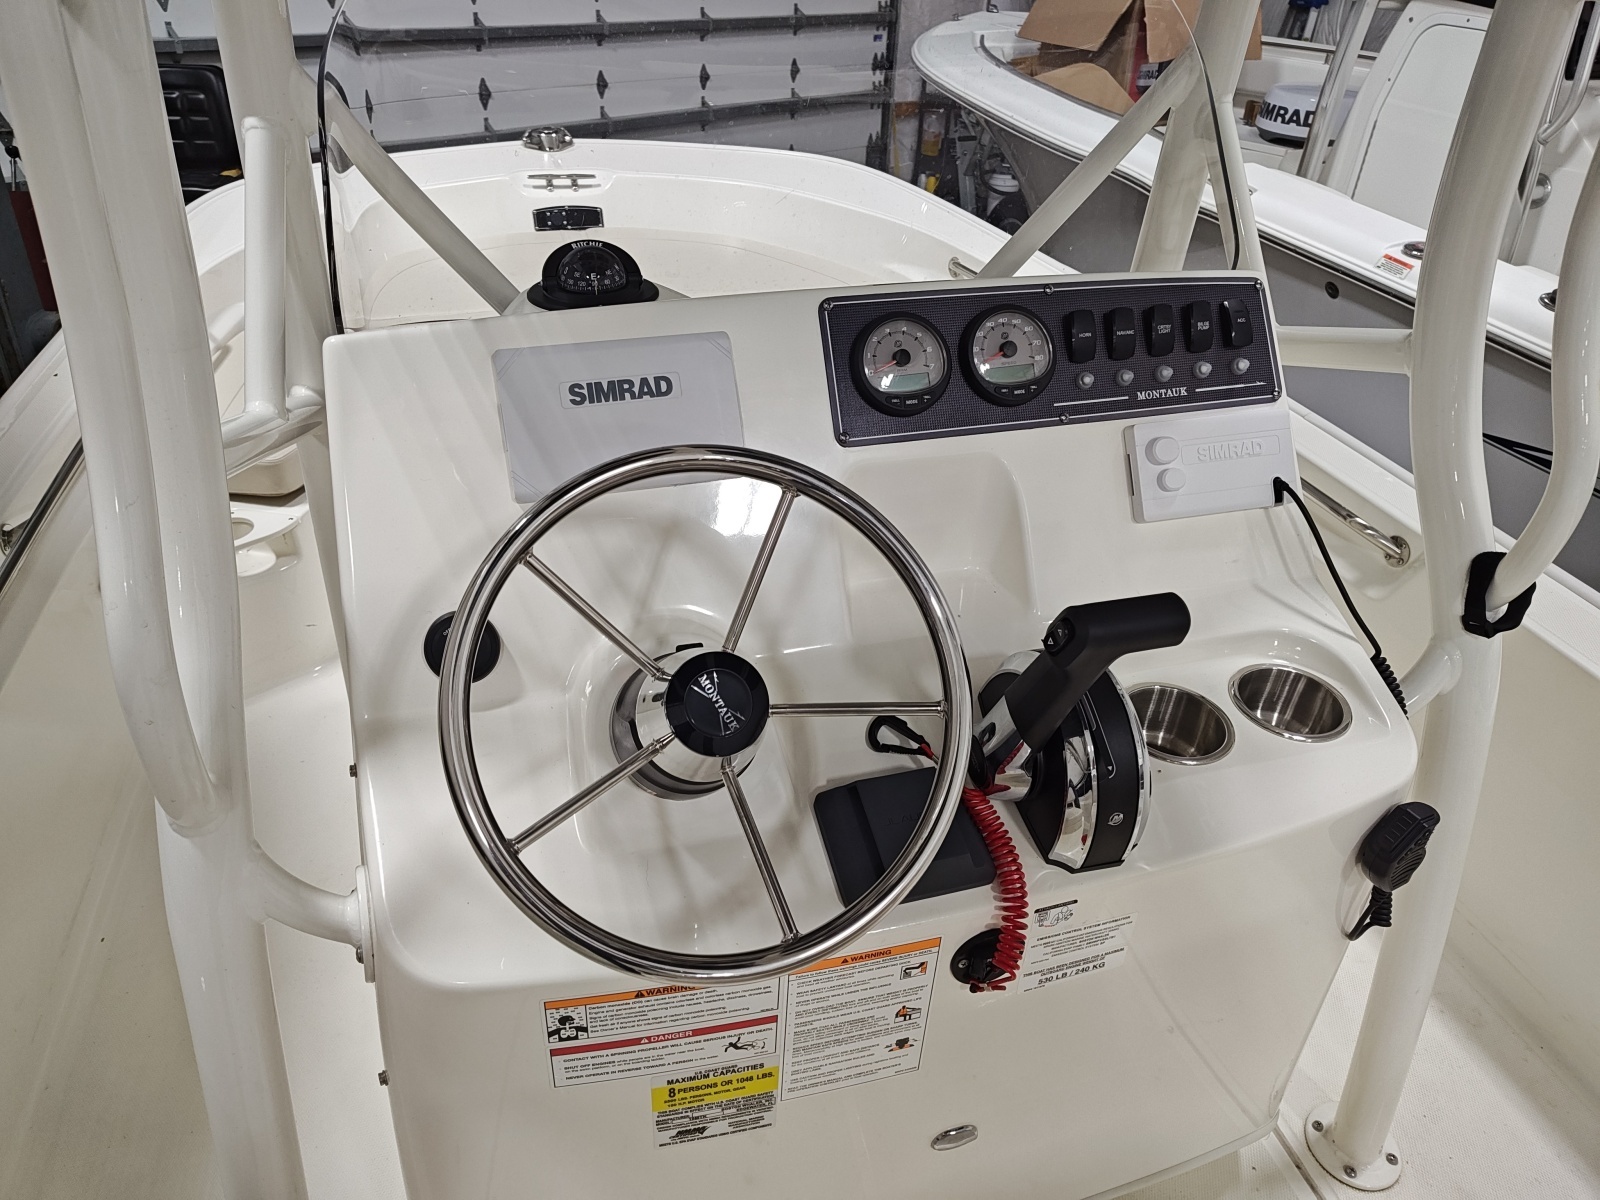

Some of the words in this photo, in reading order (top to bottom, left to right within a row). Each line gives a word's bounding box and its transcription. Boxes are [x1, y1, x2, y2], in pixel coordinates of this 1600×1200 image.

[1259, 100, 1315, 127] IMRAD
[571, 241, 603, 249] RITCHIE
[568, 375, 673, 405] SIMRAD
[1136, 386, 1187, 400] MONTAUK
[1197, 440, 1262, 462] SIMRAD
[697, 673, 739, 732] MONTAUK
[851, 950, 892, 962] WARNING
[1038, 976, 1054, 985] 530
[1056, 972, 1068, 980] LB
[1075, 966, 1090, 975] 240
[1092, 962, 1106, 970] KG
[650, 1031, 693, 1042] DANGER
[666, 1074, 710, 1085] MAXIMUM
[712, 1063, 764, 1076] CAPACITIES
[668, 1087, 676, 1099] 8
[677, 1083, 718, 1094] PERSONS
[720, 1079, 733, 1087] OR
[736, 1076, 754, 1084] 1048
[756, 1072, 775, 1080] LBS.
